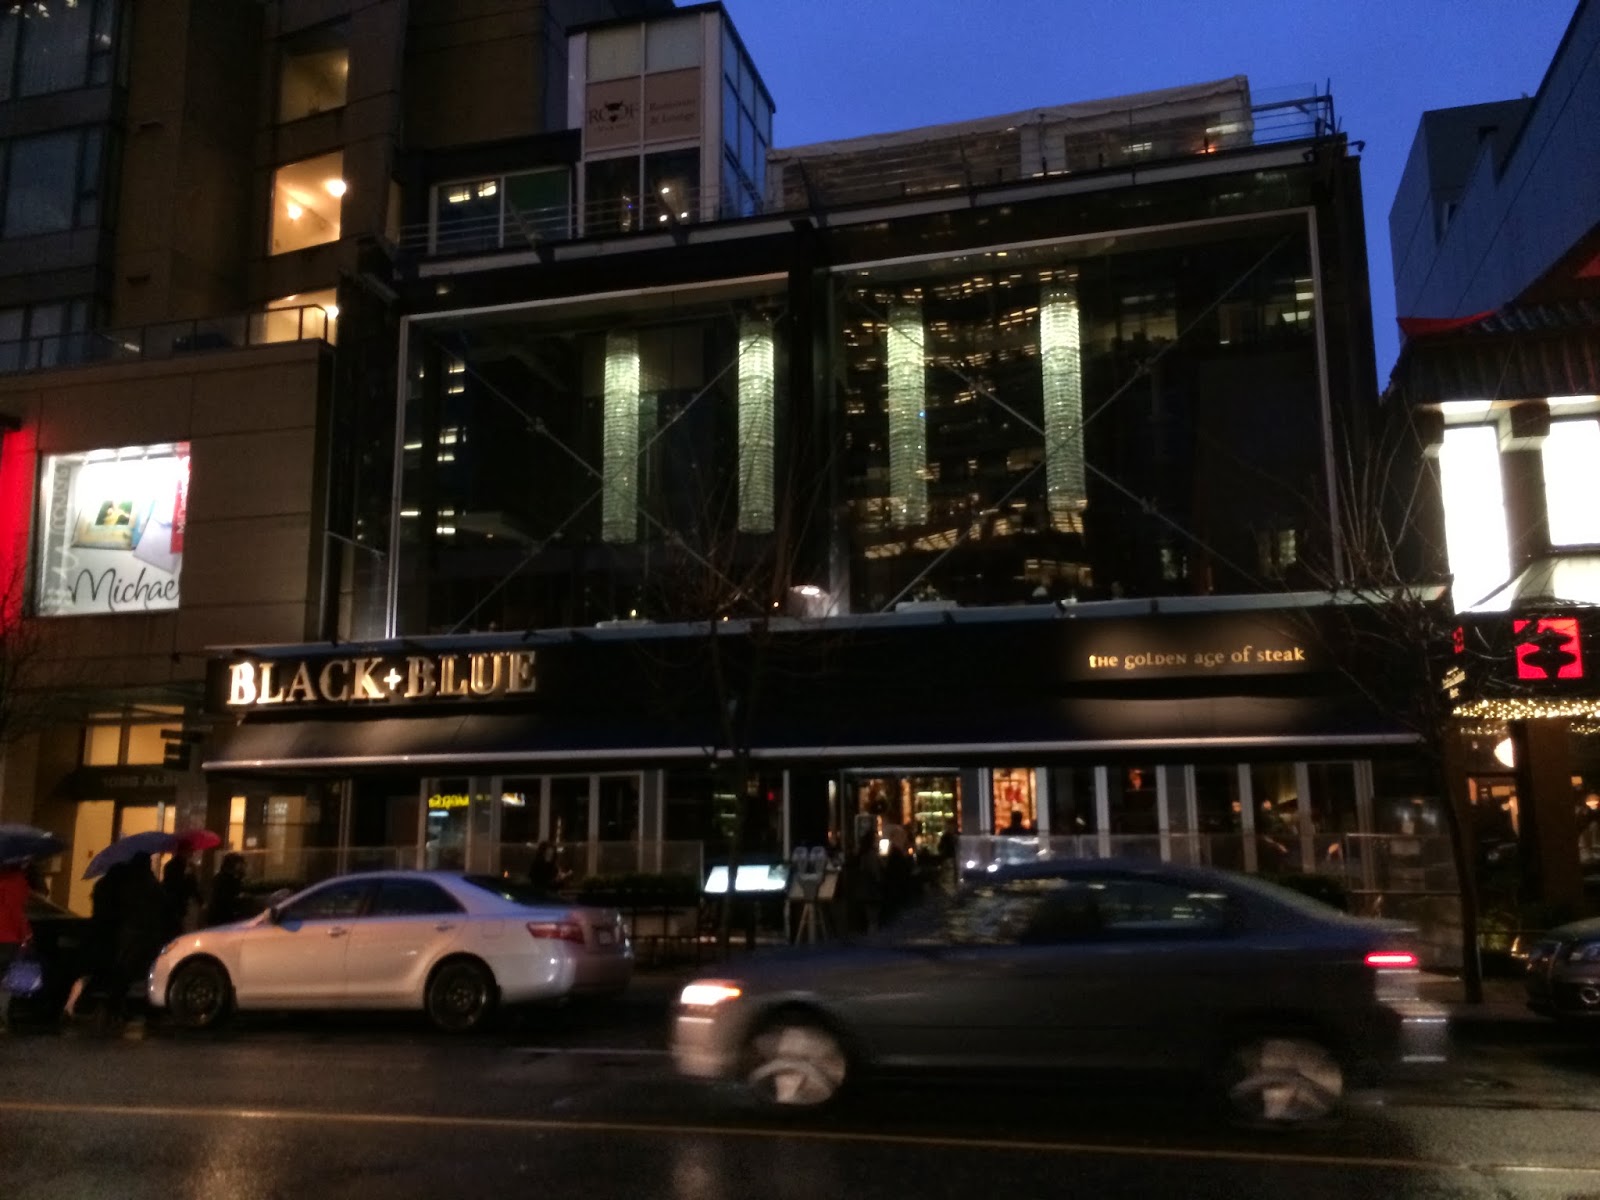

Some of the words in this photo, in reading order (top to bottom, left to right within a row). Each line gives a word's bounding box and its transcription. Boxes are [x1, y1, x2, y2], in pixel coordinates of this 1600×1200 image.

[1193, 653, 1224, 668] age
[1231, 645, 1252, 663] of
[1257, 646, 1306, 662] steak
